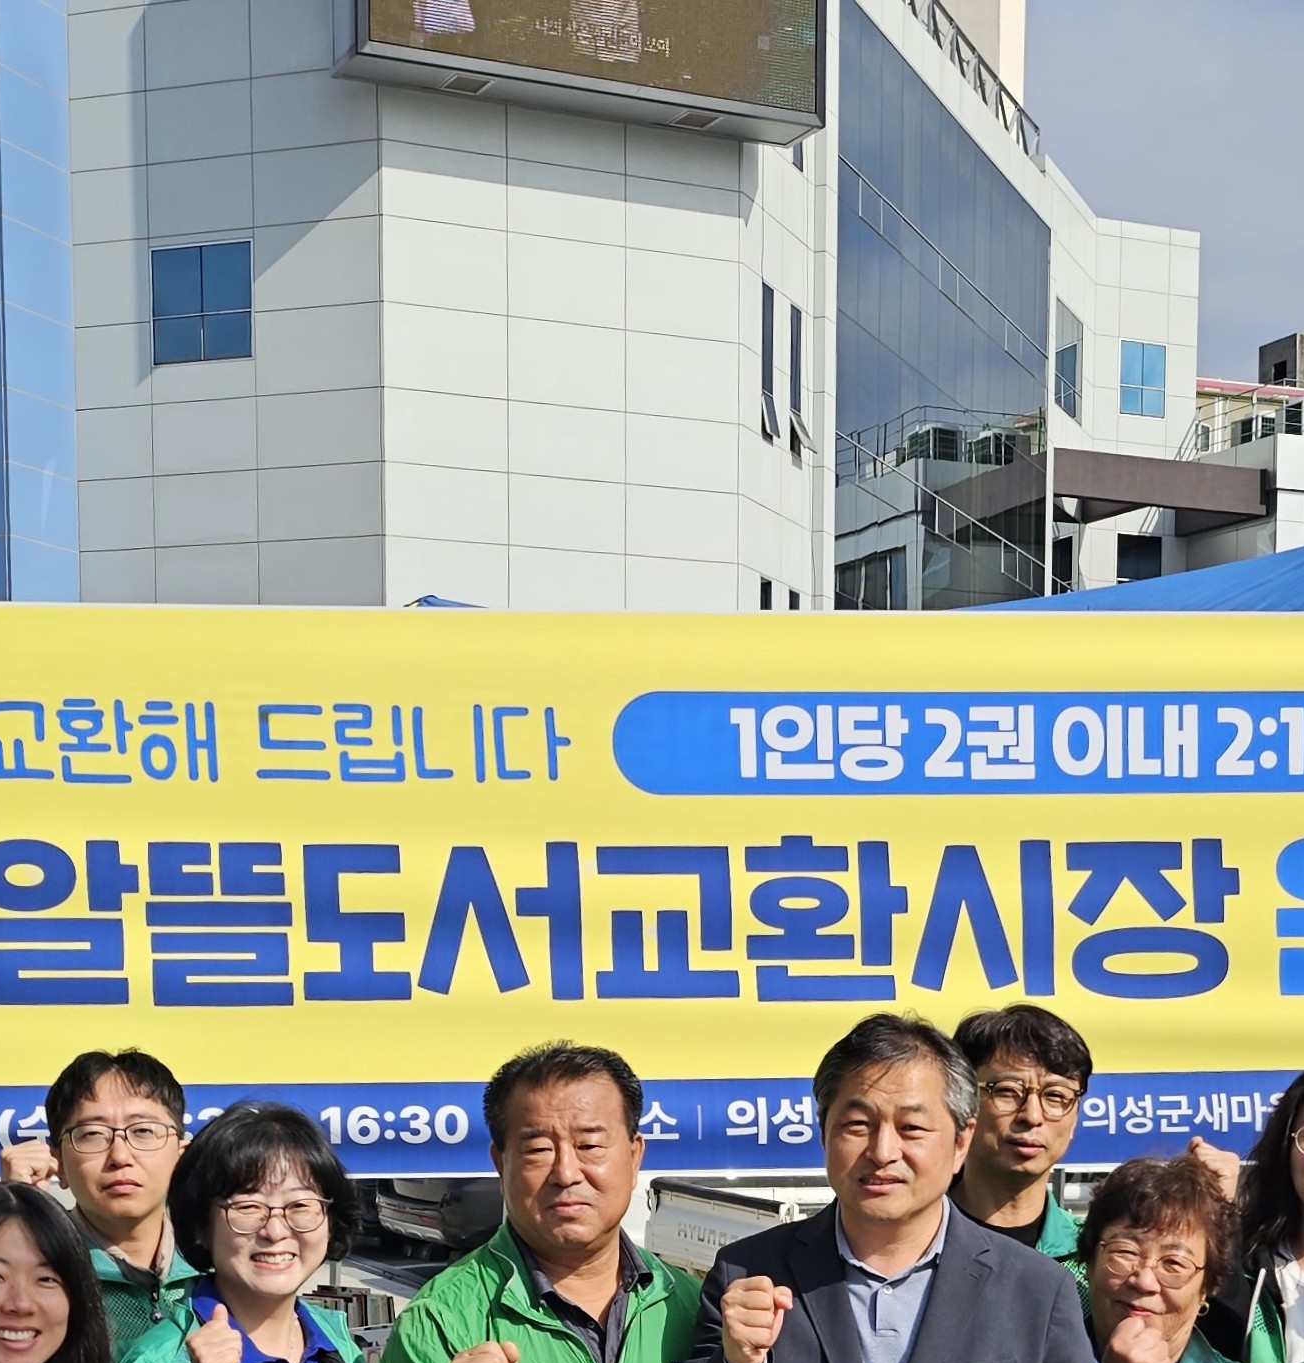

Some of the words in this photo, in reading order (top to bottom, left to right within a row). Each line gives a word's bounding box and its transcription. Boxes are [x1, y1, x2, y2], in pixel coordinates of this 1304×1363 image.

[256, 703, 572, 784] 드립니다
[729, 704, 910, 782] 1인당
[924, 705, 1036, 780] 2권
[1052, 705, 1199, 780] 이내
[320, 1104, 470, 1146] 16:30
[637, 1101, 680, 1141] 소
[725, 1096, 819, 1145] 의성
